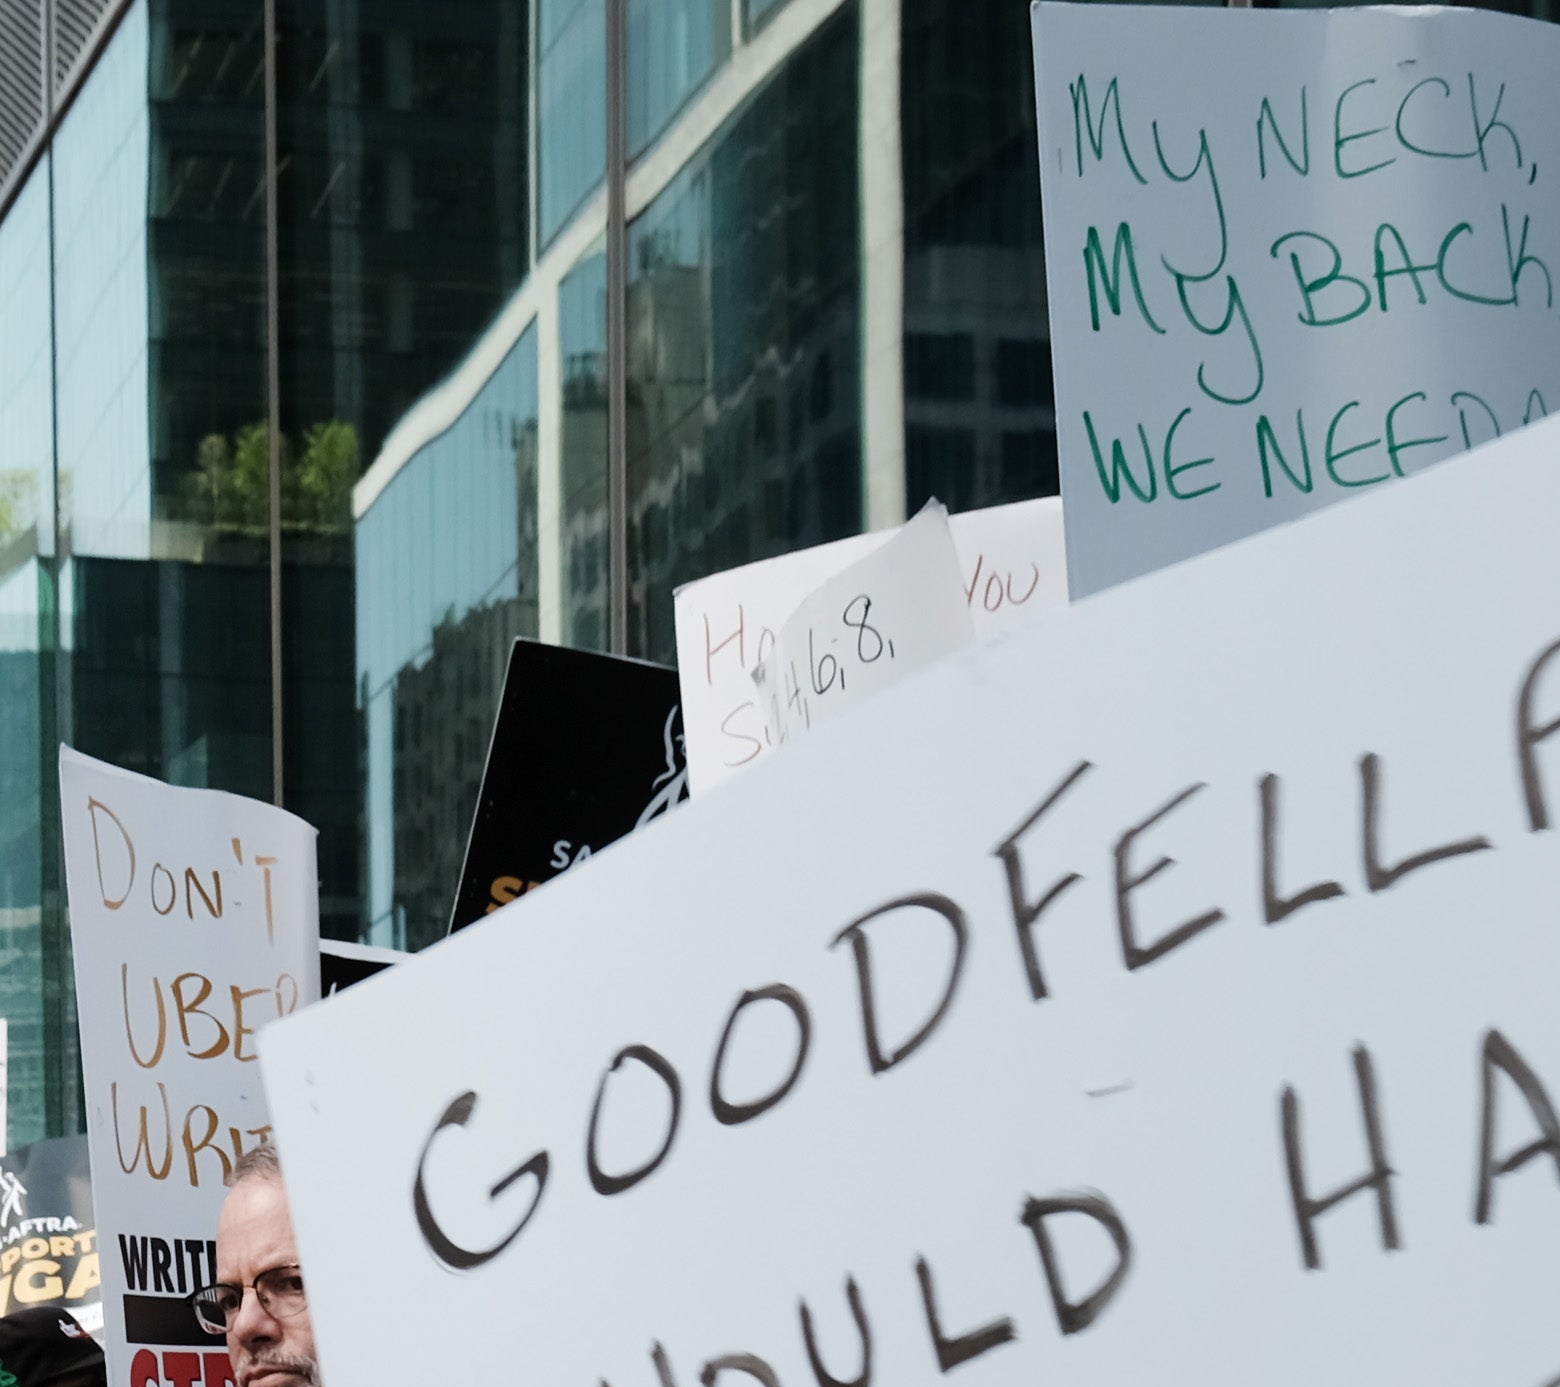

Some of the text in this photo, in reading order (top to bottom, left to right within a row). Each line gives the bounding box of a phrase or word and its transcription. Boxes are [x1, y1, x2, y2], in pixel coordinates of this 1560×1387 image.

[1256, 71, 1537, 186] NECK,
[1083, 405, 1222, 504] WE
[964, 554, 1040, 613] YOU
[117, 1233, 218, 1294] WRIT
